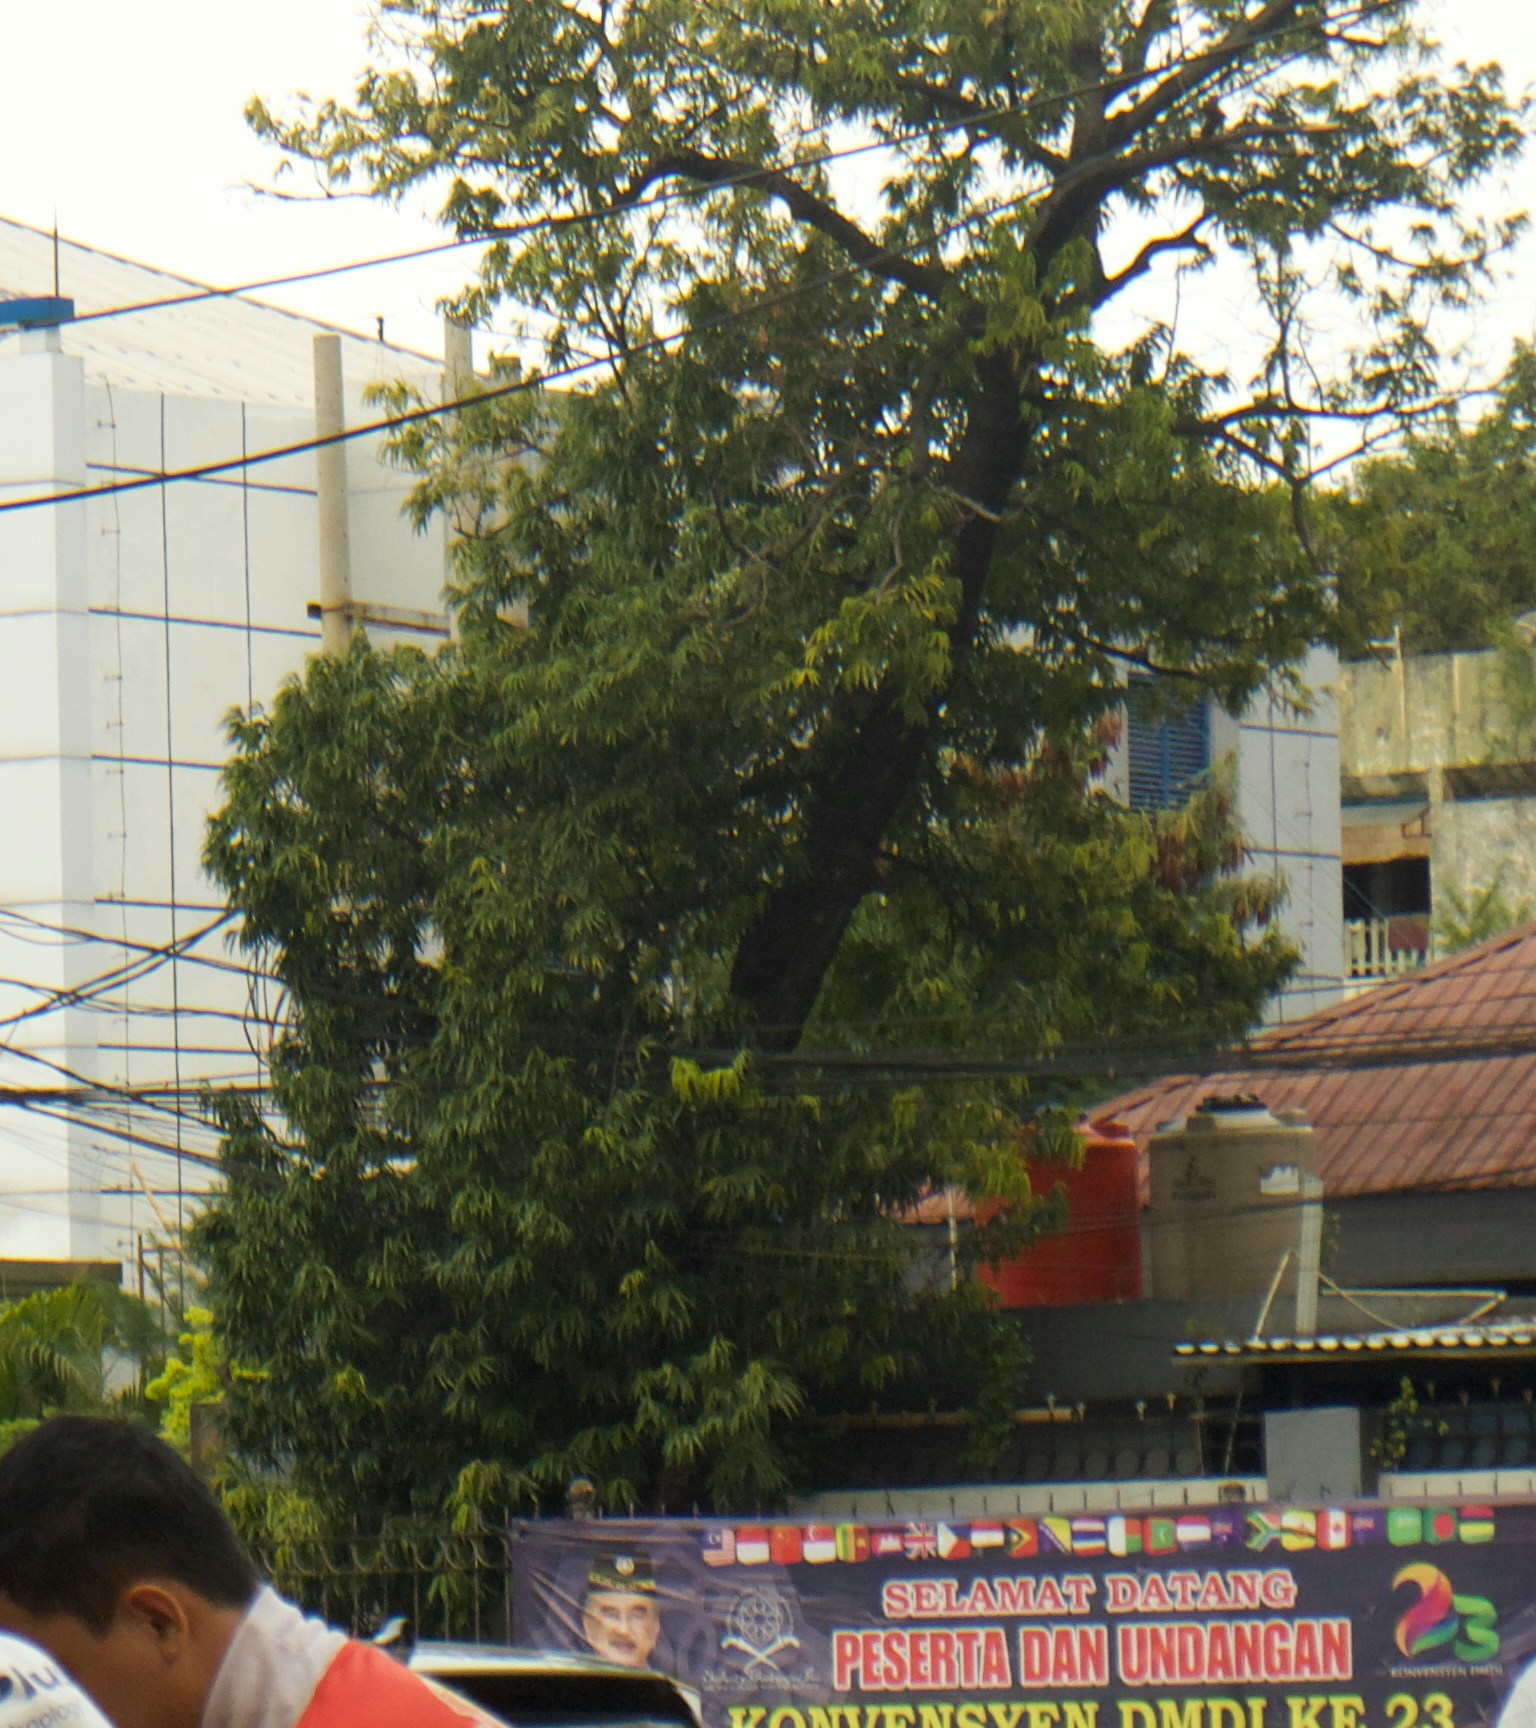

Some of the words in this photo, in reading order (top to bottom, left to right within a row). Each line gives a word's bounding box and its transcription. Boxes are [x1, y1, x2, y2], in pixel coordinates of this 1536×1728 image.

[882, 1575, 1097, 1619] SELAMAT
[1105, 1567, 1298, 1613] DATANG
[832, 1626, 1012, 1691] PESERTA
[1018, 1622, 1109, 1688] DAN
[1116, 1617, 1353, 1686] UNDANGAN
